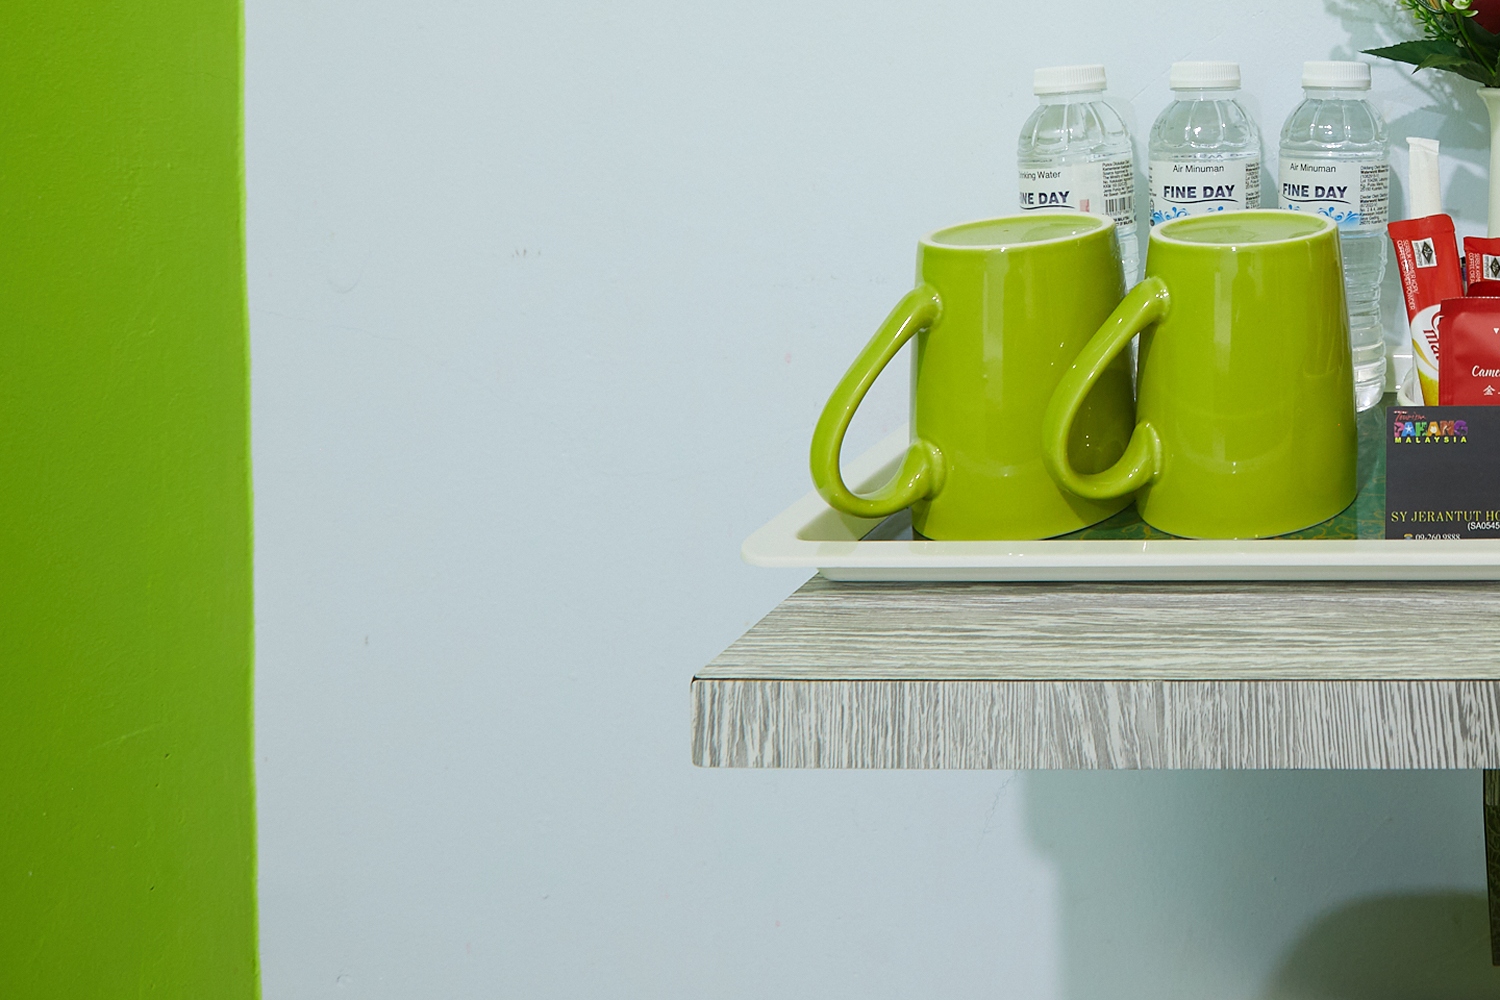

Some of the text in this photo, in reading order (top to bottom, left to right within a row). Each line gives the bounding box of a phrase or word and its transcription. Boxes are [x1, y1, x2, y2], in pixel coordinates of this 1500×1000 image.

[1172, 164, 1225, 173] Air Minuman
[1289, 163, 1337, 173] Air Minuman
[1037, 171, 1062, 179] Water
[1163, 184, 1236, 199] FINE DAY
[1282, 183, 1348, 199] FINE DAY
[1038, 190, 1070, 205] DAY
[1394, 419, 1468, 438] PAHANG
[1394, 436, 1468, 444] MALAYSIA
[1391, 510, 1408, 522] SY
[1411, 510, 1482, 522] JERANTUT
